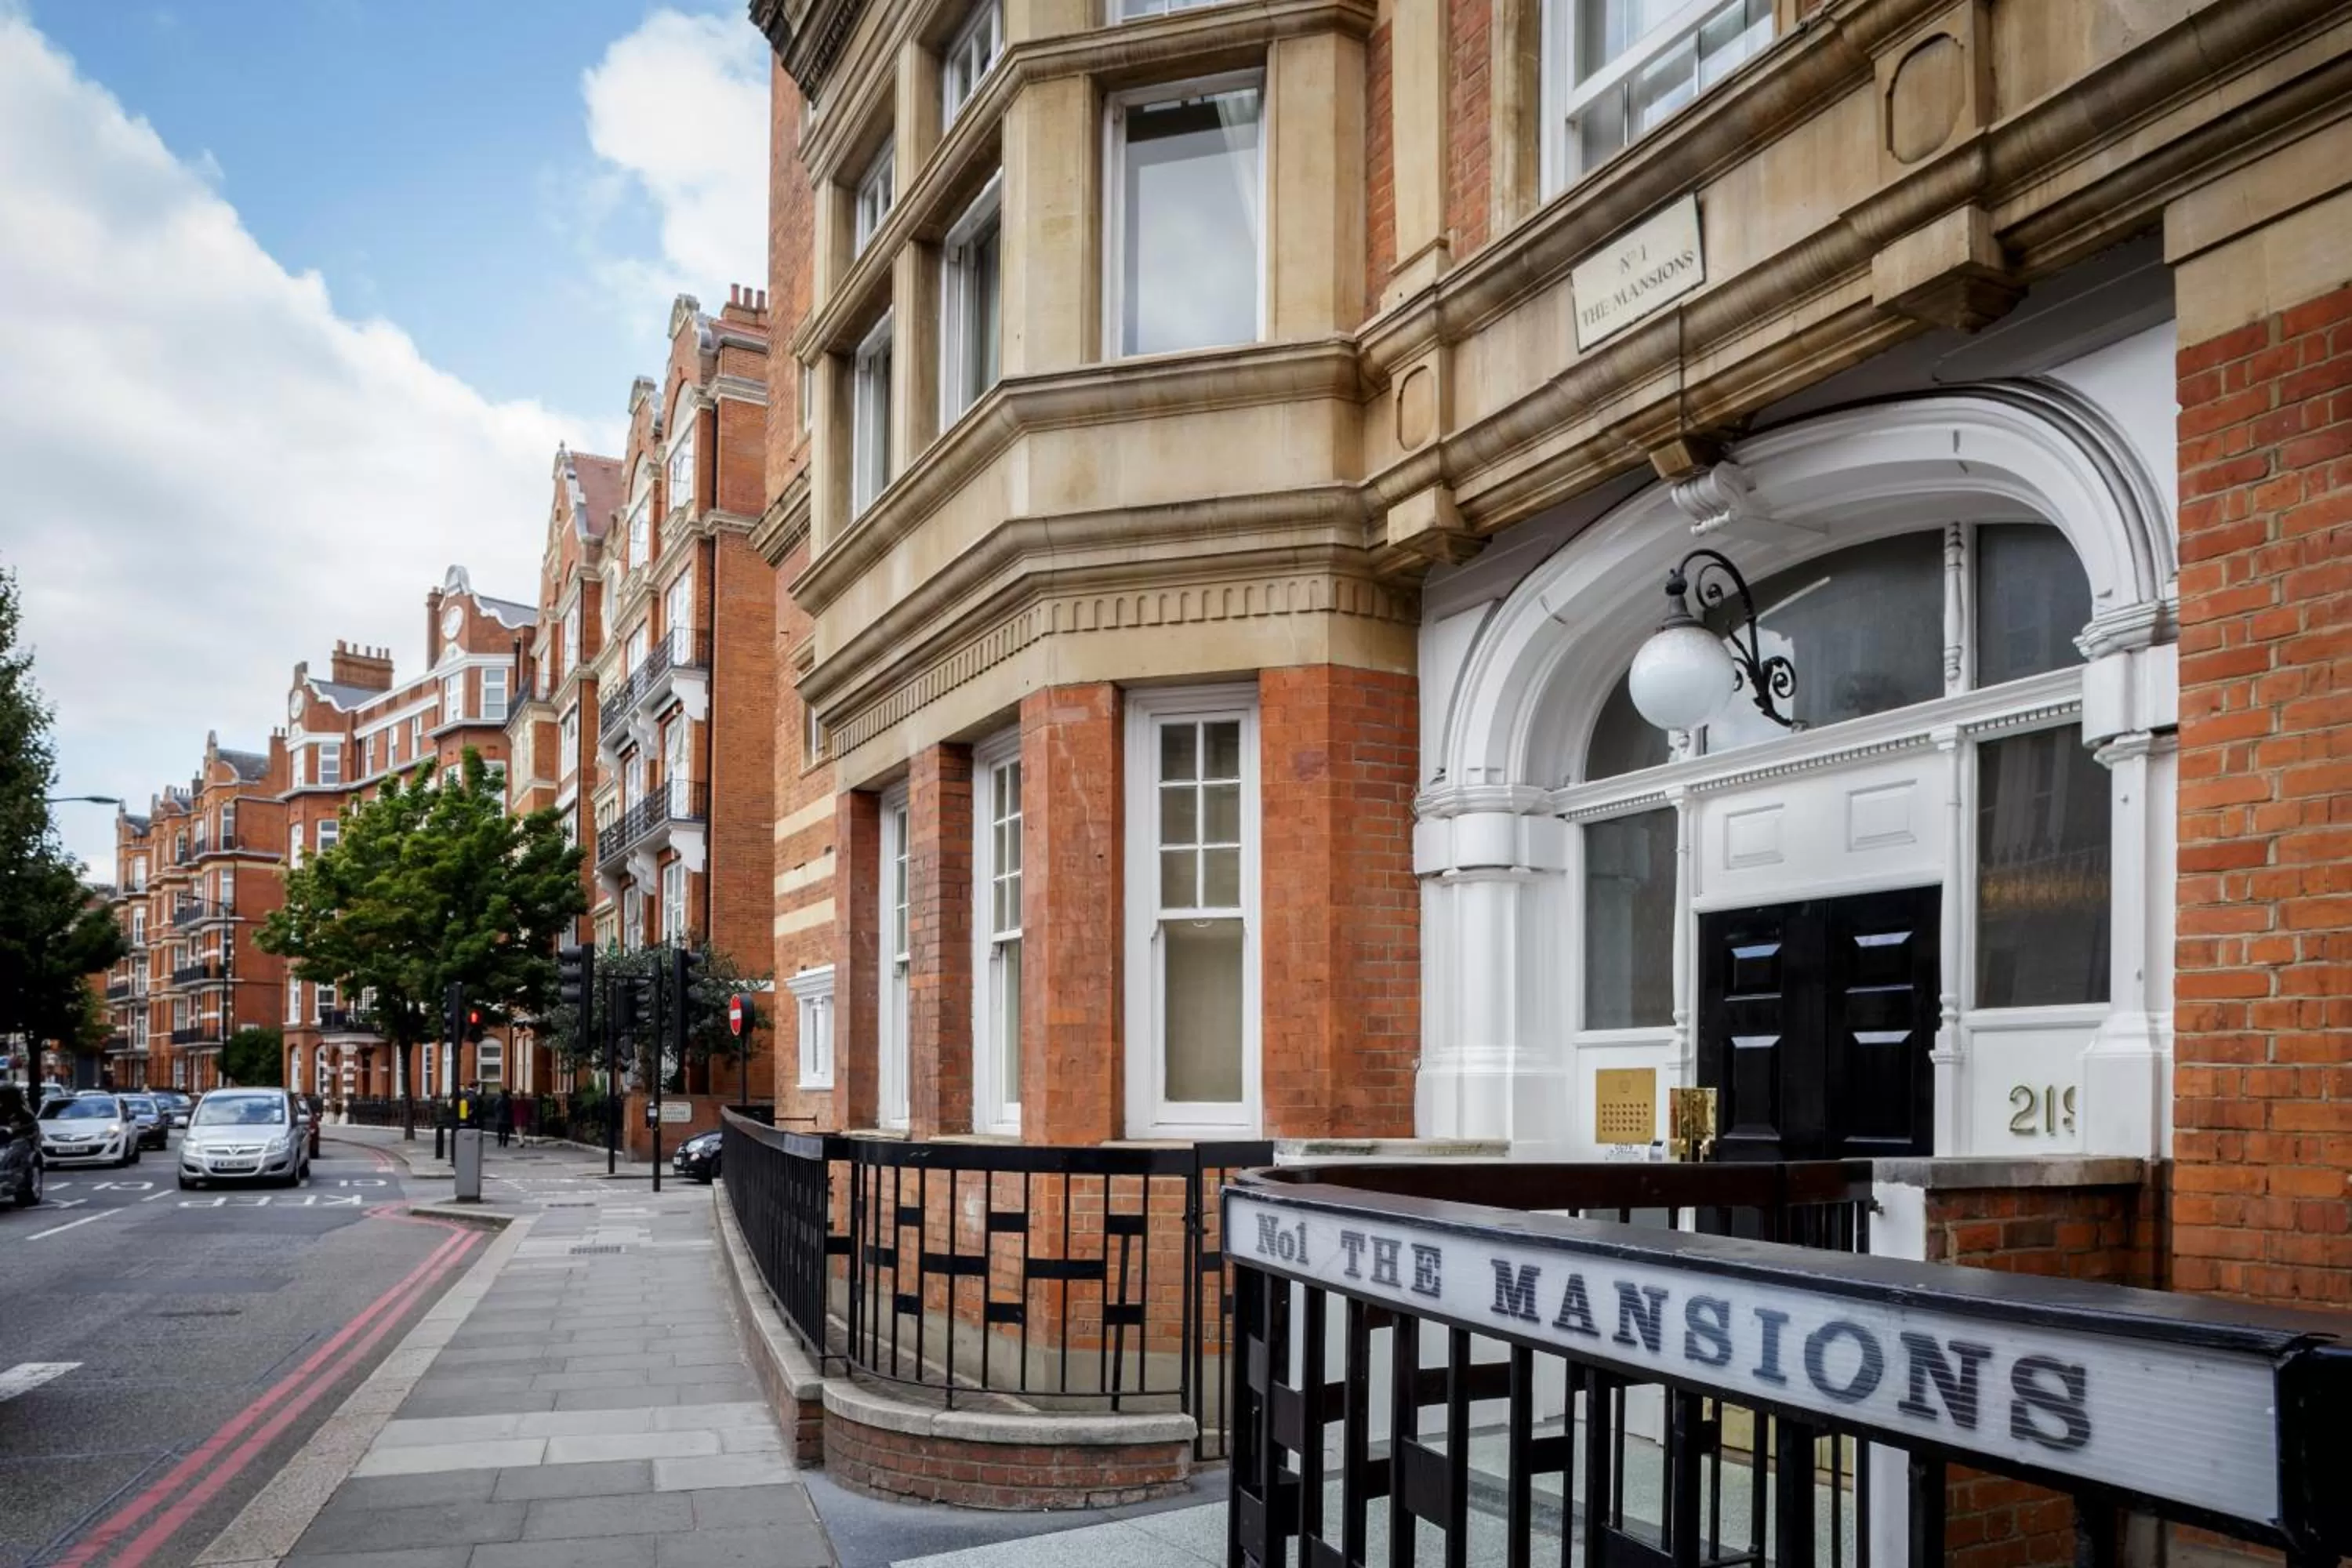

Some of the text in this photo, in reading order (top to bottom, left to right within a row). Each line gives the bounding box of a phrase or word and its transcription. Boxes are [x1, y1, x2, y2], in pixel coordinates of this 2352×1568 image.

[1581, 249, 1695, 328] THE MANSIONS
[1340, 1229, 1443, 1298] THE
[1490, 1258, 2092, 1452] MANSIONS
